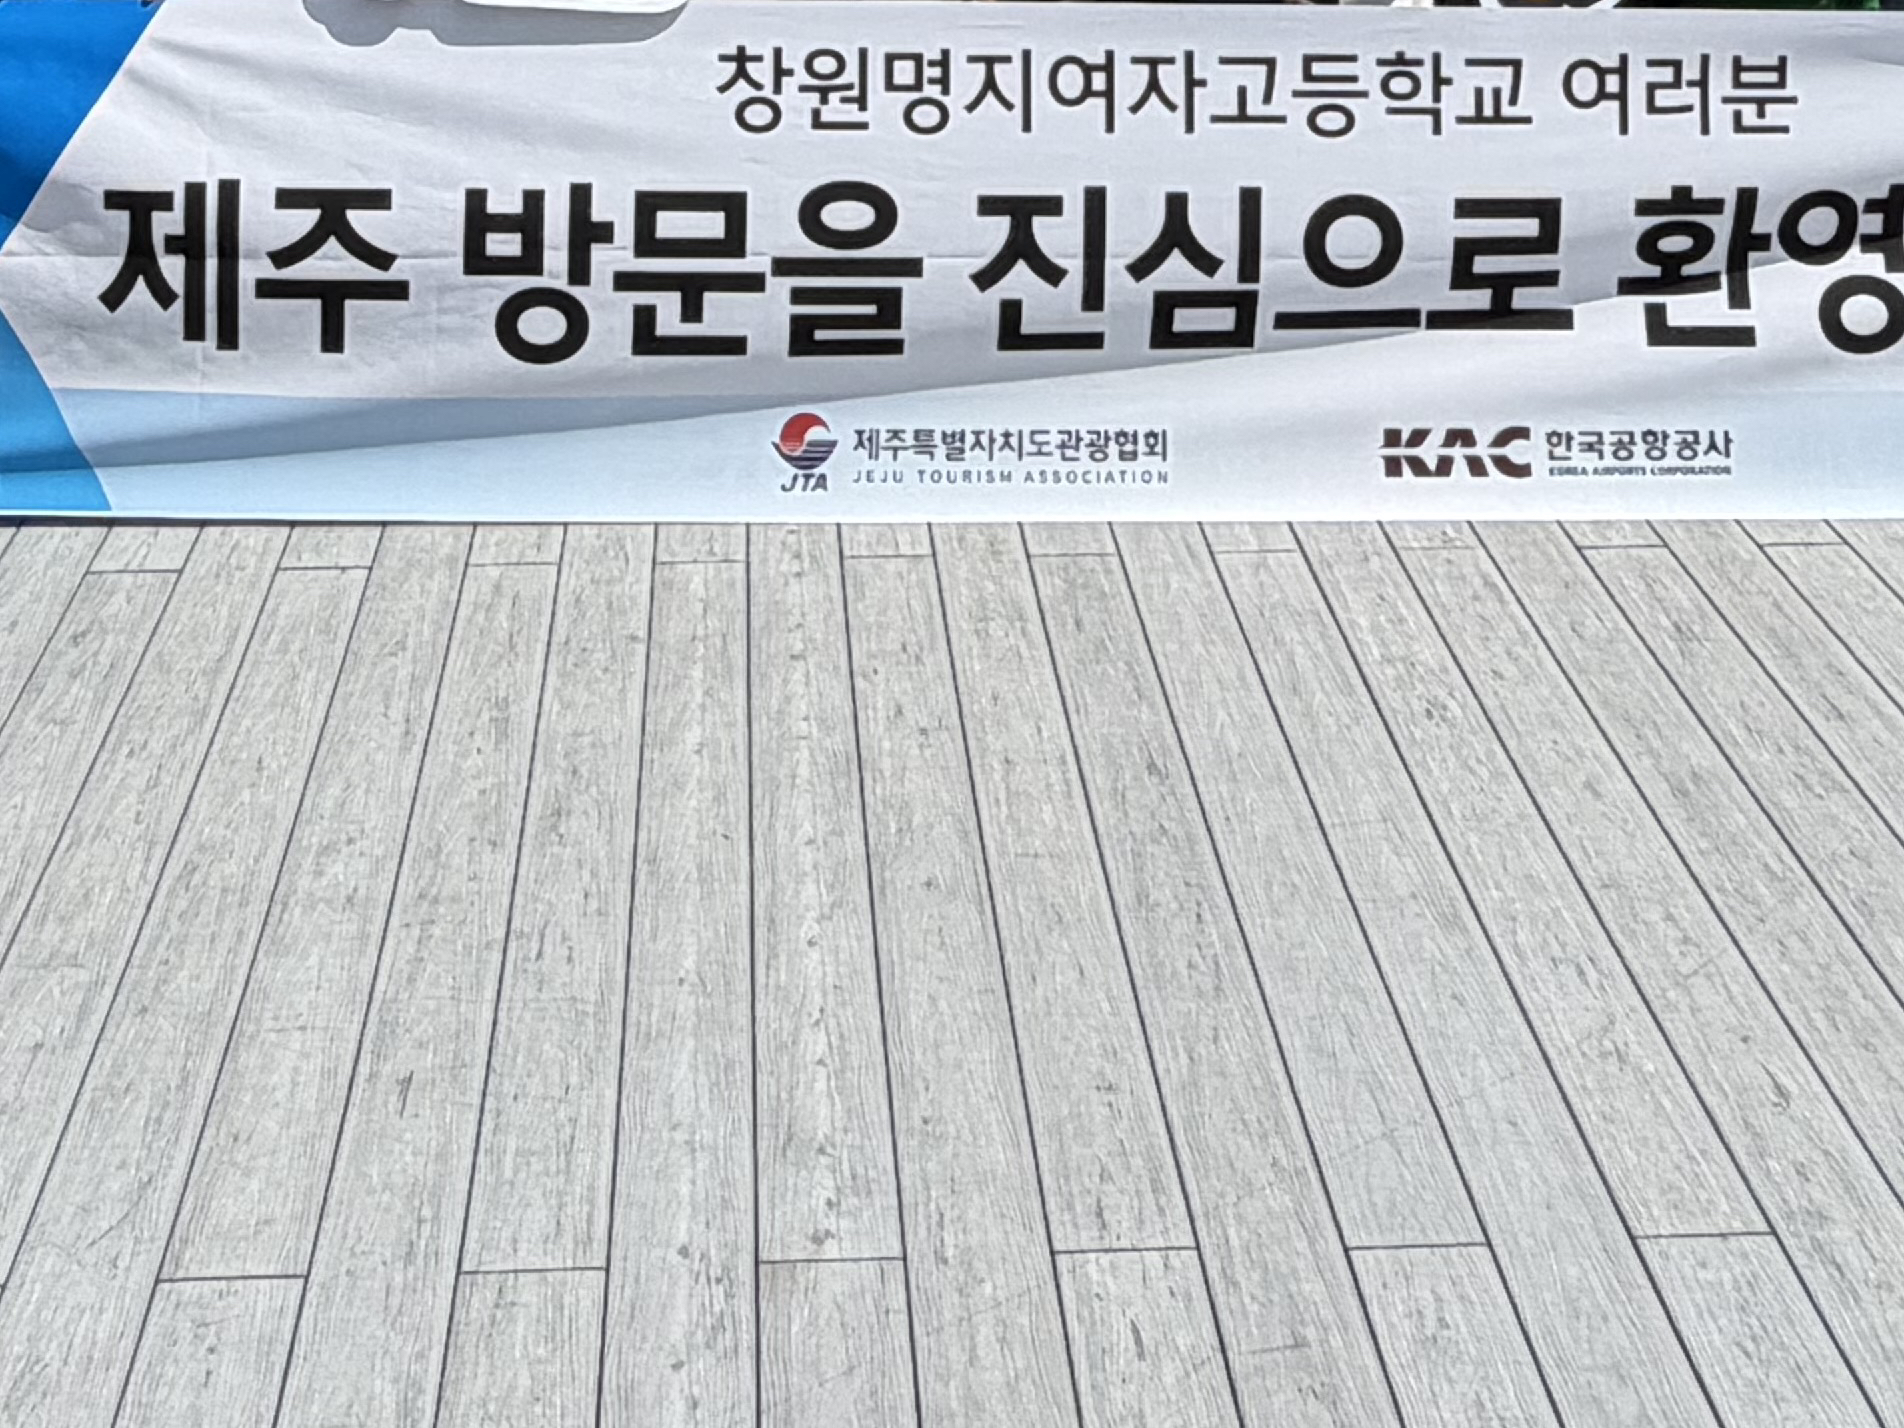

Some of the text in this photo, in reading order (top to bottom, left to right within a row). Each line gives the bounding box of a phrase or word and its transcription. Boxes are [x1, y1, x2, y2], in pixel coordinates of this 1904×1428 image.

[715, 44, 1798, 137] 창원명지여자고등학교 여러분
[97, 178, 412, 354] 제주
[462, 179, 924, 366] 방문을
[968, 185, 1576, 353] 진심으로
[852, 427, 1169, 463] 제주특별자치도관광협회
[1379, 426, 1532, 478] KAC
[1544, 429, 1735, 462] 한국공항공사
[780, 472, 829, 493] JTA
[852, 469, 1169, 485] JEJU TOURISM ASSOCIATION
